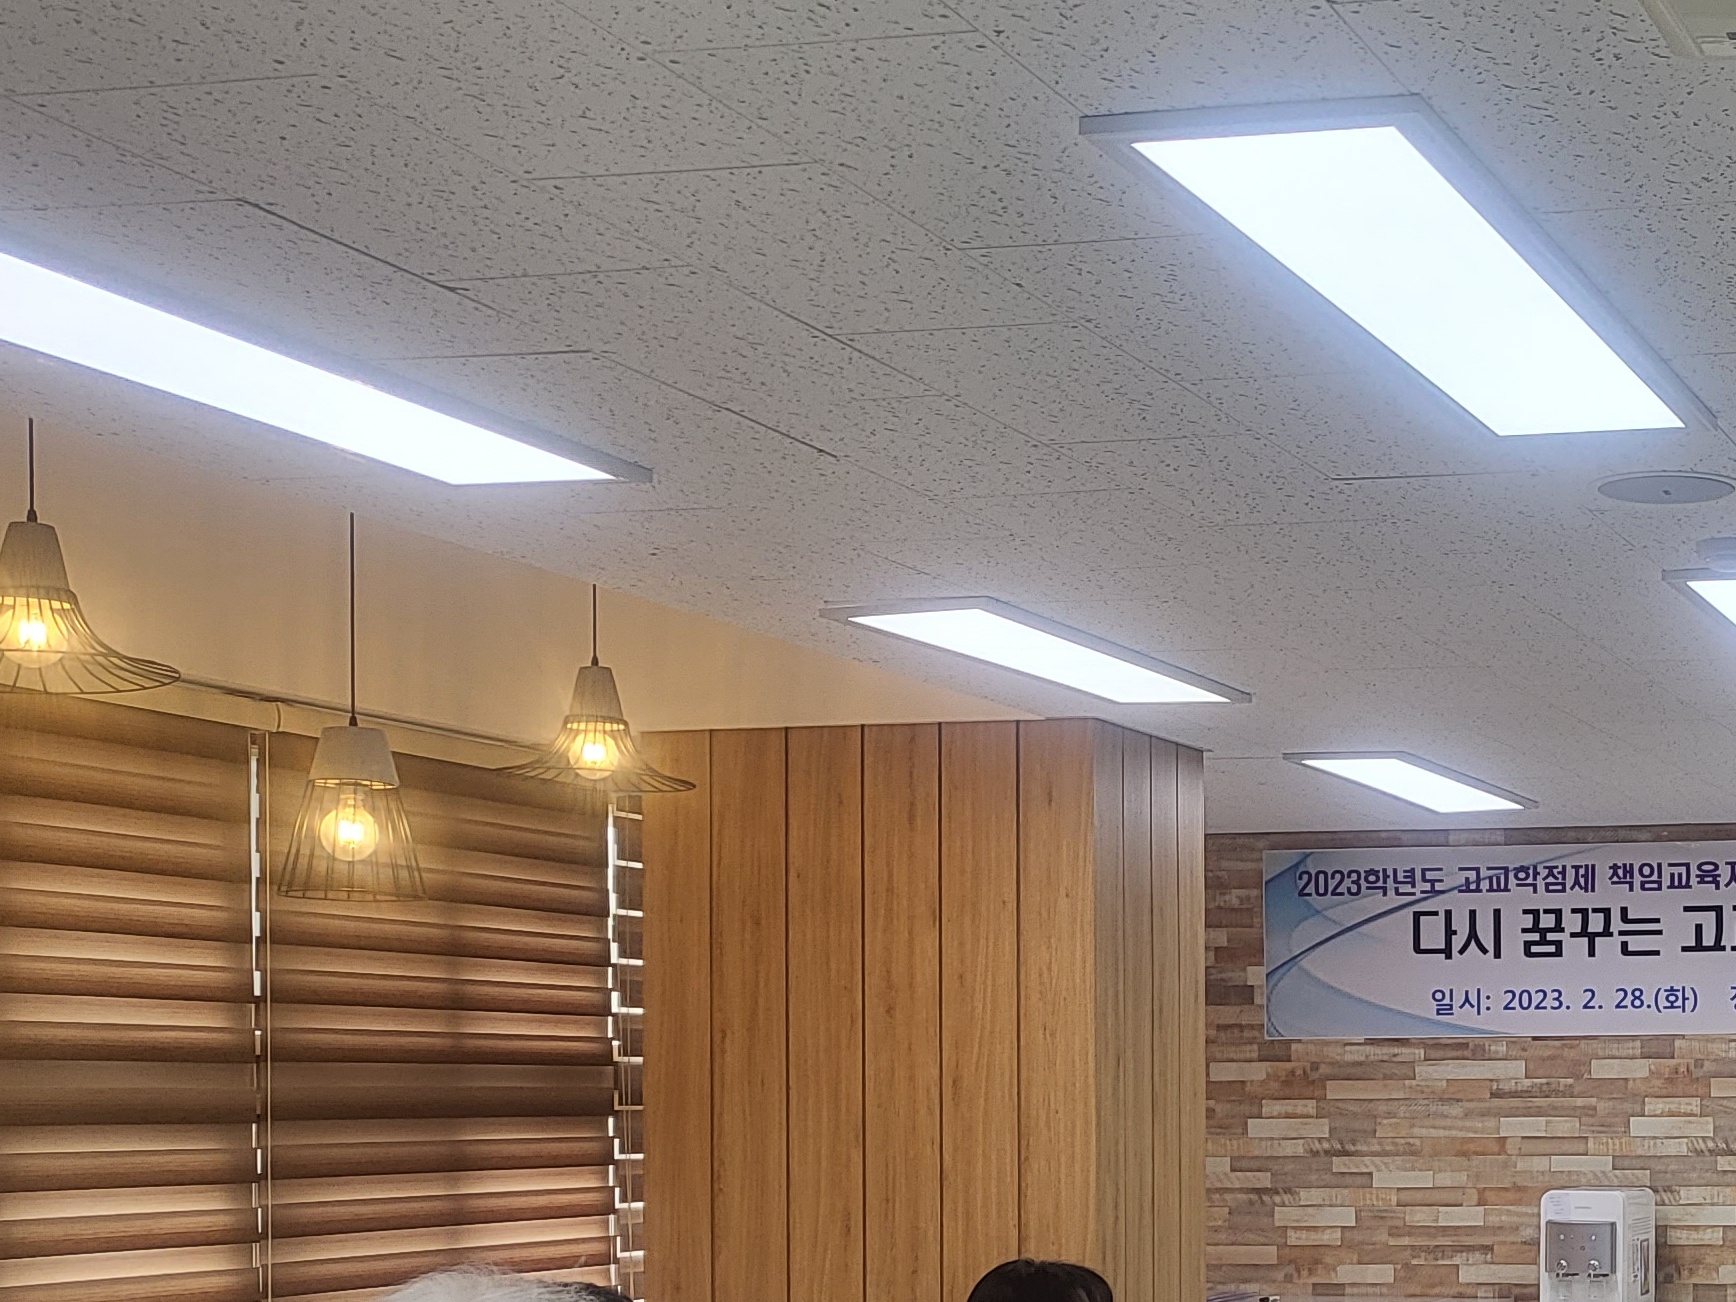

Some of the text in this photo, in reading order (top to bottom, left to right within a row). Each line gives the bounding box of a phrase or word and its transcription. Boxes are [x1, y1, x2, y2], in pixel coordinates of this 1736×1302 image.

[1297, 867, 1445, 898] 2023학년도
[1457, 863, 1596, 894] 고교학점제
[1412, 907, 1502, 961] 다시
[1520, 906, 1664, 958] 꿈꾸는
[1431, 987, 1491, 1016] 일시:
[1502, 988, 1571, 1011] 2023.
[1582, 988, 1604, 1010] 2.
[1614, 985, 1698, 1013] 28.(화)
